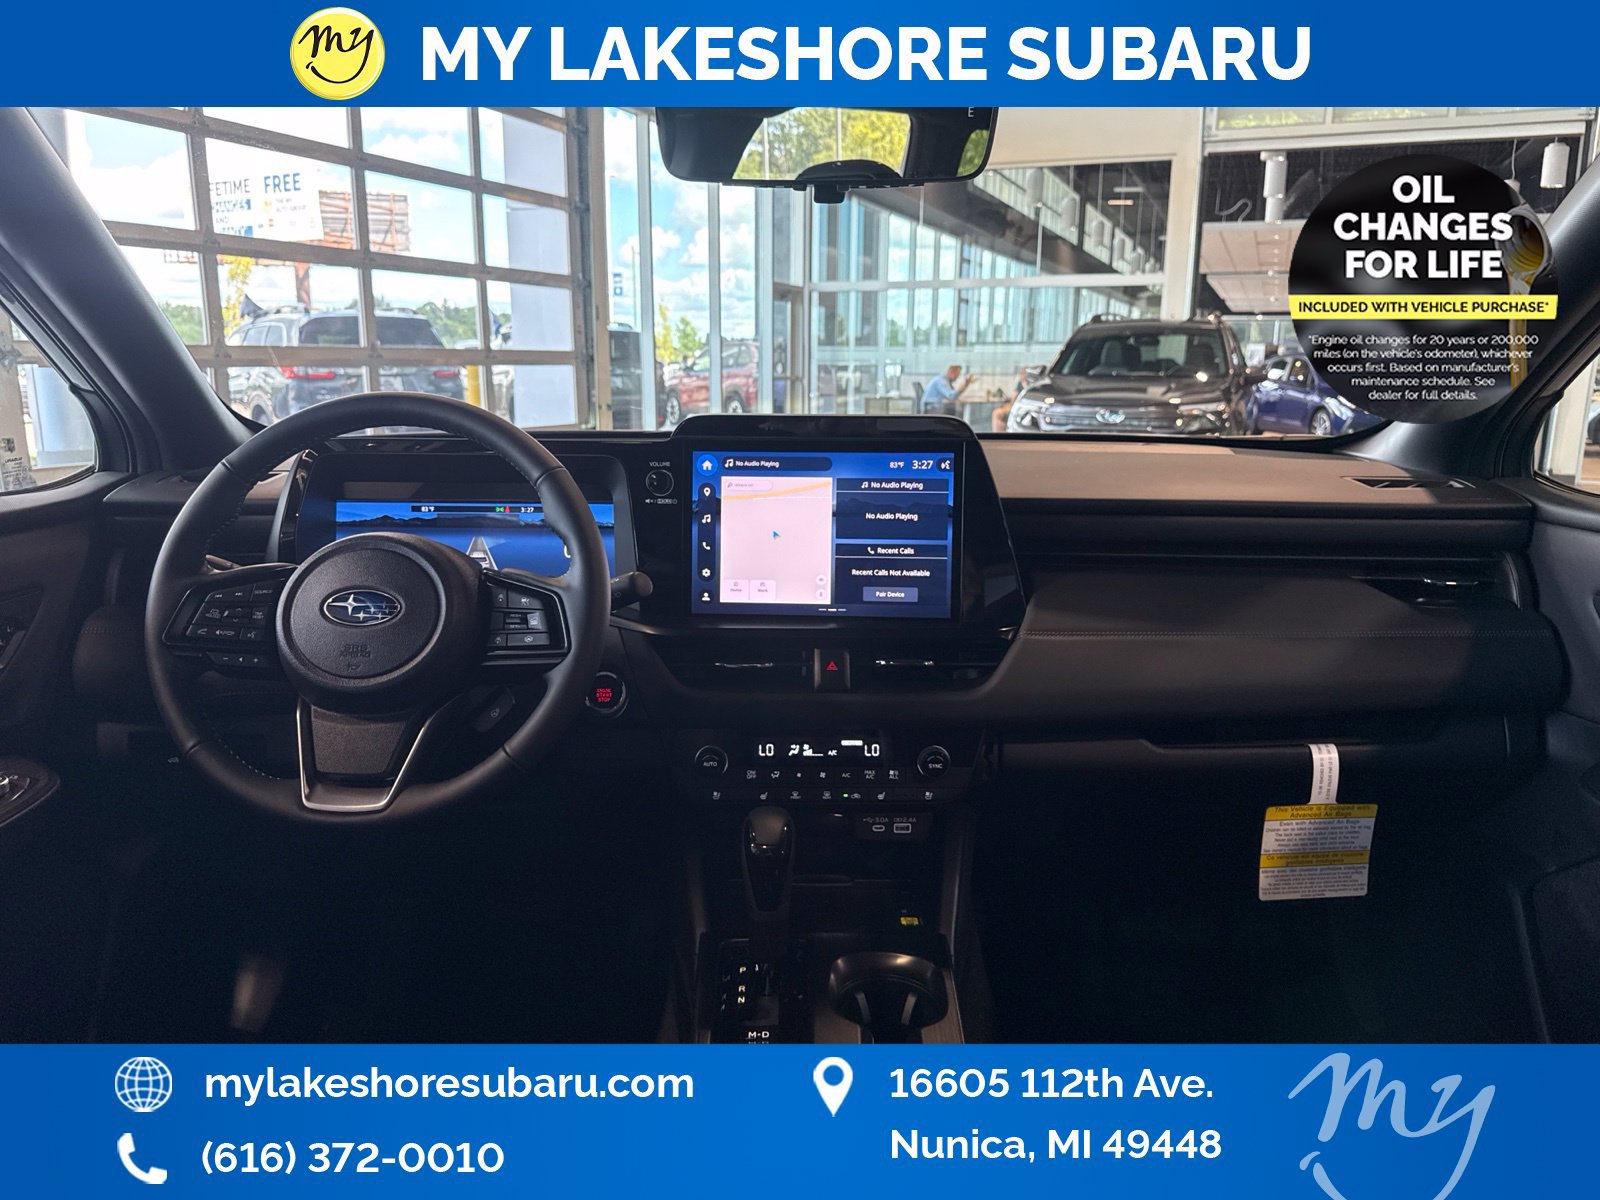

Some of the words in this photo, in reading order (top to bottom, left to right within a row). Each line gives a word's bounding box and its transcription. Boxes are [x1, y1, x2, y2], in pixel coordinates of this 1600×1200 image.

[264, 172, 301, 193] FREE
[760, 460, 780, 469] Playing
[912, 460, 933, 470] 3:27
[900, 481, 924, 490] Playing
[895, 512, 918, 521] Playing
[739, 966, 747, 974] P
[737, 996, 746, 1004] N
